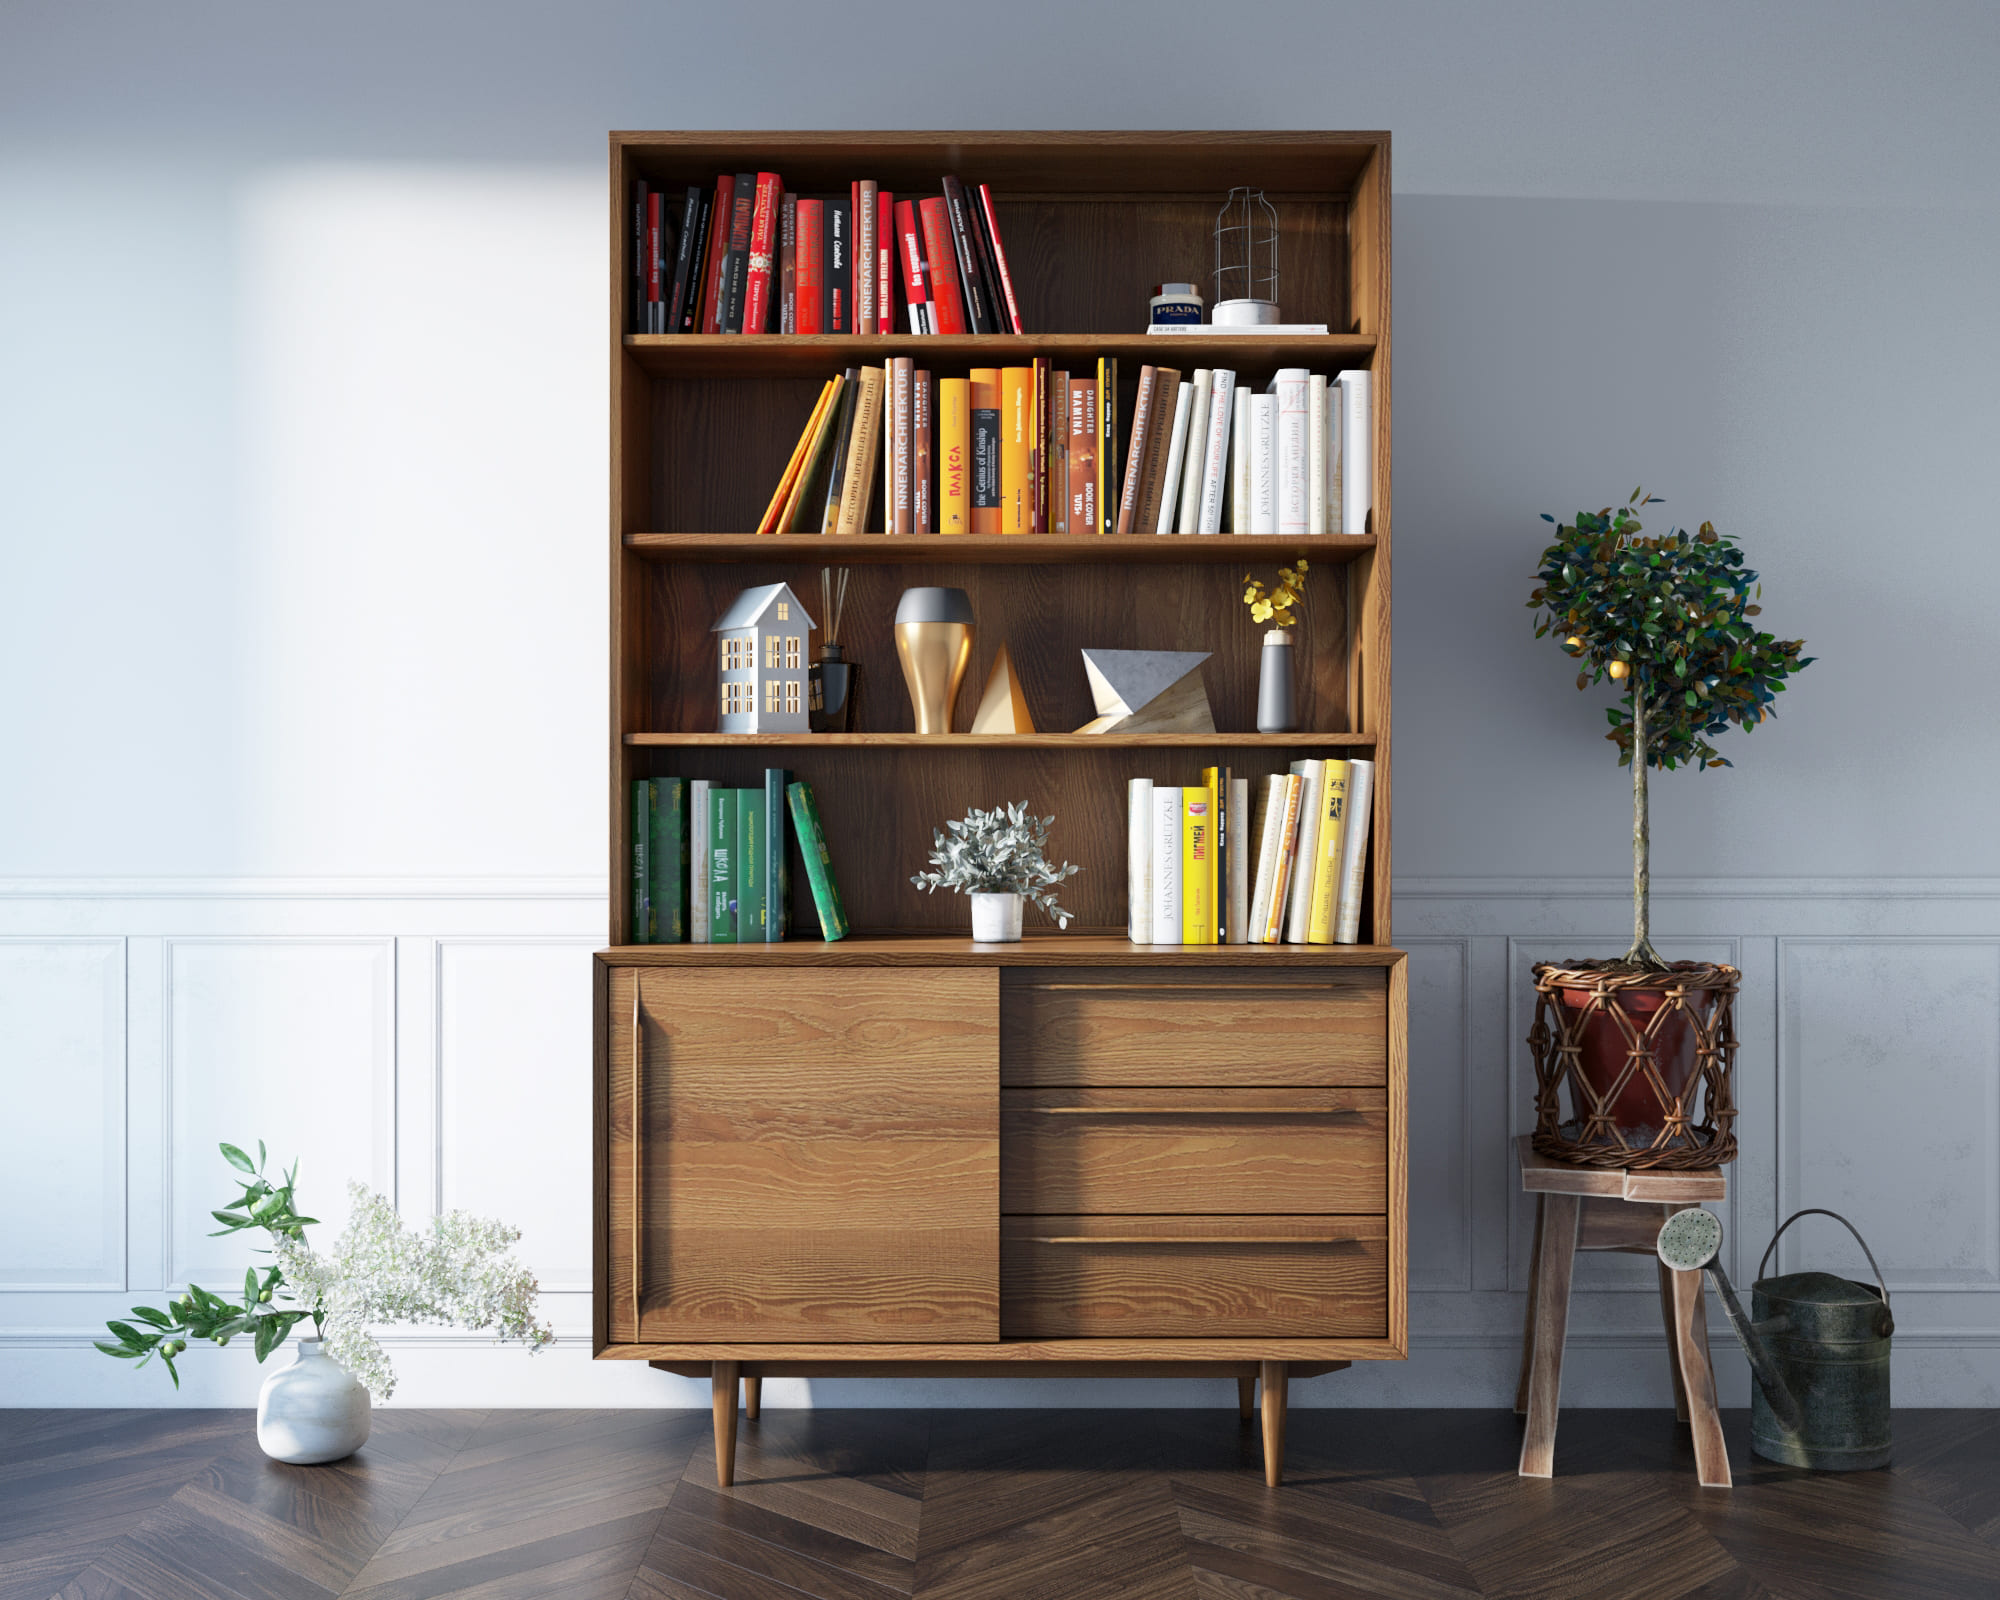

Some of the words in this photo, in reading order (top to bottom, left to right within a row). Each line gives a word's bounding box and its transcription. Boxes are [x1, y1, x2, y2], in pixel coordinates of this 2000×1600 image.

[864, 190, 872, 319] INNENARCHITEKTUR
[732, 258, 740, 293] BROWN
[799, 271, 808, 286] DIE
[1157, 306, 1199, 315] PRADA
[1056, 378, 1064, 440] CHOICES
[1073, 391, 1082, 435] MAMINA
[1216, 406, 1225, 427] LOVE
[898, 368, 908, 509] INNENARCHITEKTUR
[976, 428, 988, 453] Kinship
[1125, 375, 1151, 511] INNENARCHITEKTUR
[1212, 440, 1221, 460] YOUR
[1214, 428, 1222, 438] OF
[949, 446, 962, 497] ПЛАКСА
[976, 455, 985, 464] of
[1210, 462, 1218, 477] LIFE
[976, 465, 985, 492] Genius
[1207, 480, 1217, 503] AFTER
[1262, 457, 1270, 516] JOHANNES
[846, 480, 858, 525] ИСТОРИЯ
[976, 495, 985, 506] the
[1074, 494, 1082, 515] TUTS+
[1285, 782, 1300, 850] CHOICES
[1191, 825, 1205, 861] ПИГМЕЙ
[713, 849, 728, 883] ШКОЛА
[1164, 855, 1174, 920] JOHANNES
